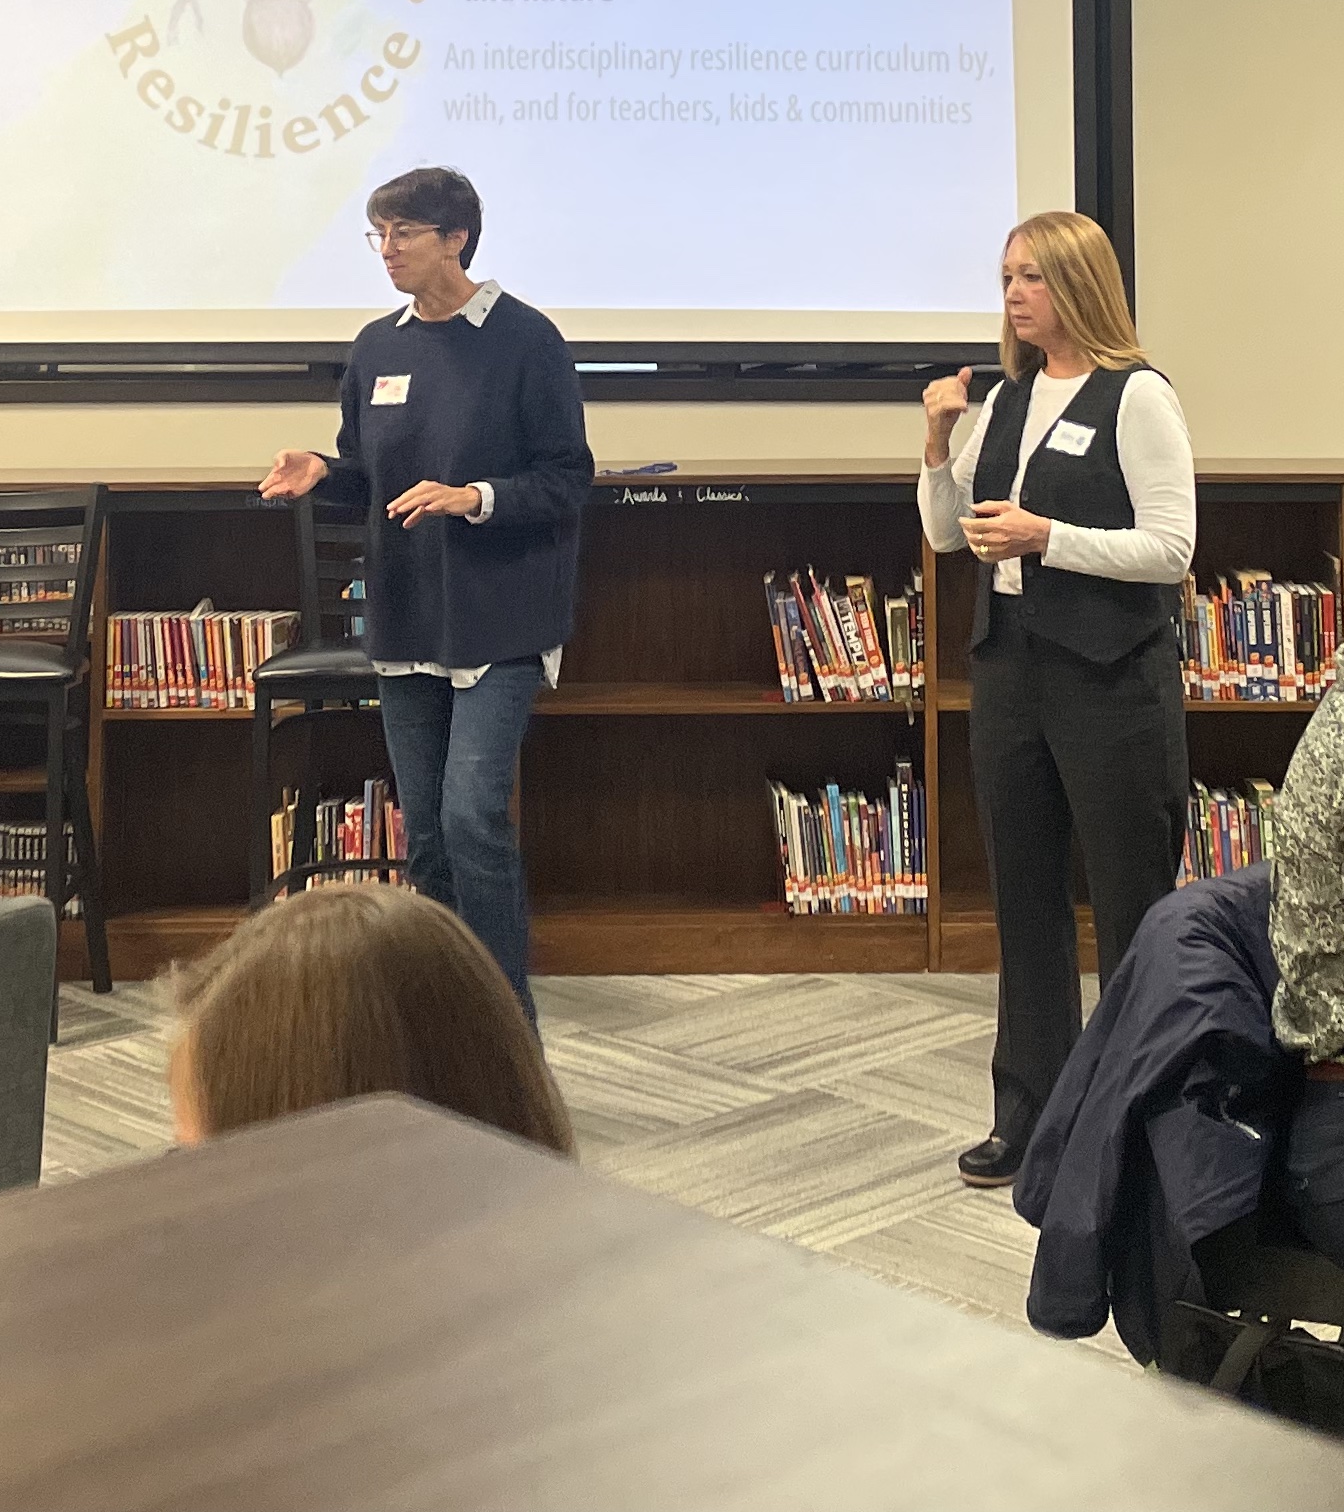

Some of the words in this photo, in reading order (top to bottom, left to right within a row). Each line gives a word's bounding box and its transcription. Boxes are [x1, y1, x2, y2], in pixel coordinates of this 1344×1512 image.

[443, 42, 475, 71] An
[483, 40, 683, 79] interdisciplinary
[690, 41, 808, 72] resilience
[815, 42, 950, 73] curriculum
[959, 42, 995, 82] by,
[104, 13, 422, 160] Resilience
[442, 91, 505, 126] with,
[512, 91, 559, 122] and
[566, 90, 602, 122] for
[609, 91, 721, 127] teachers,
[729, 92, 779, 123] kids
[785, 93, 803, 123] &
[810, 94, 973, 125] communities
[622, 487, 668, 505] Awards
[696, 487, 743, 504] Classics
